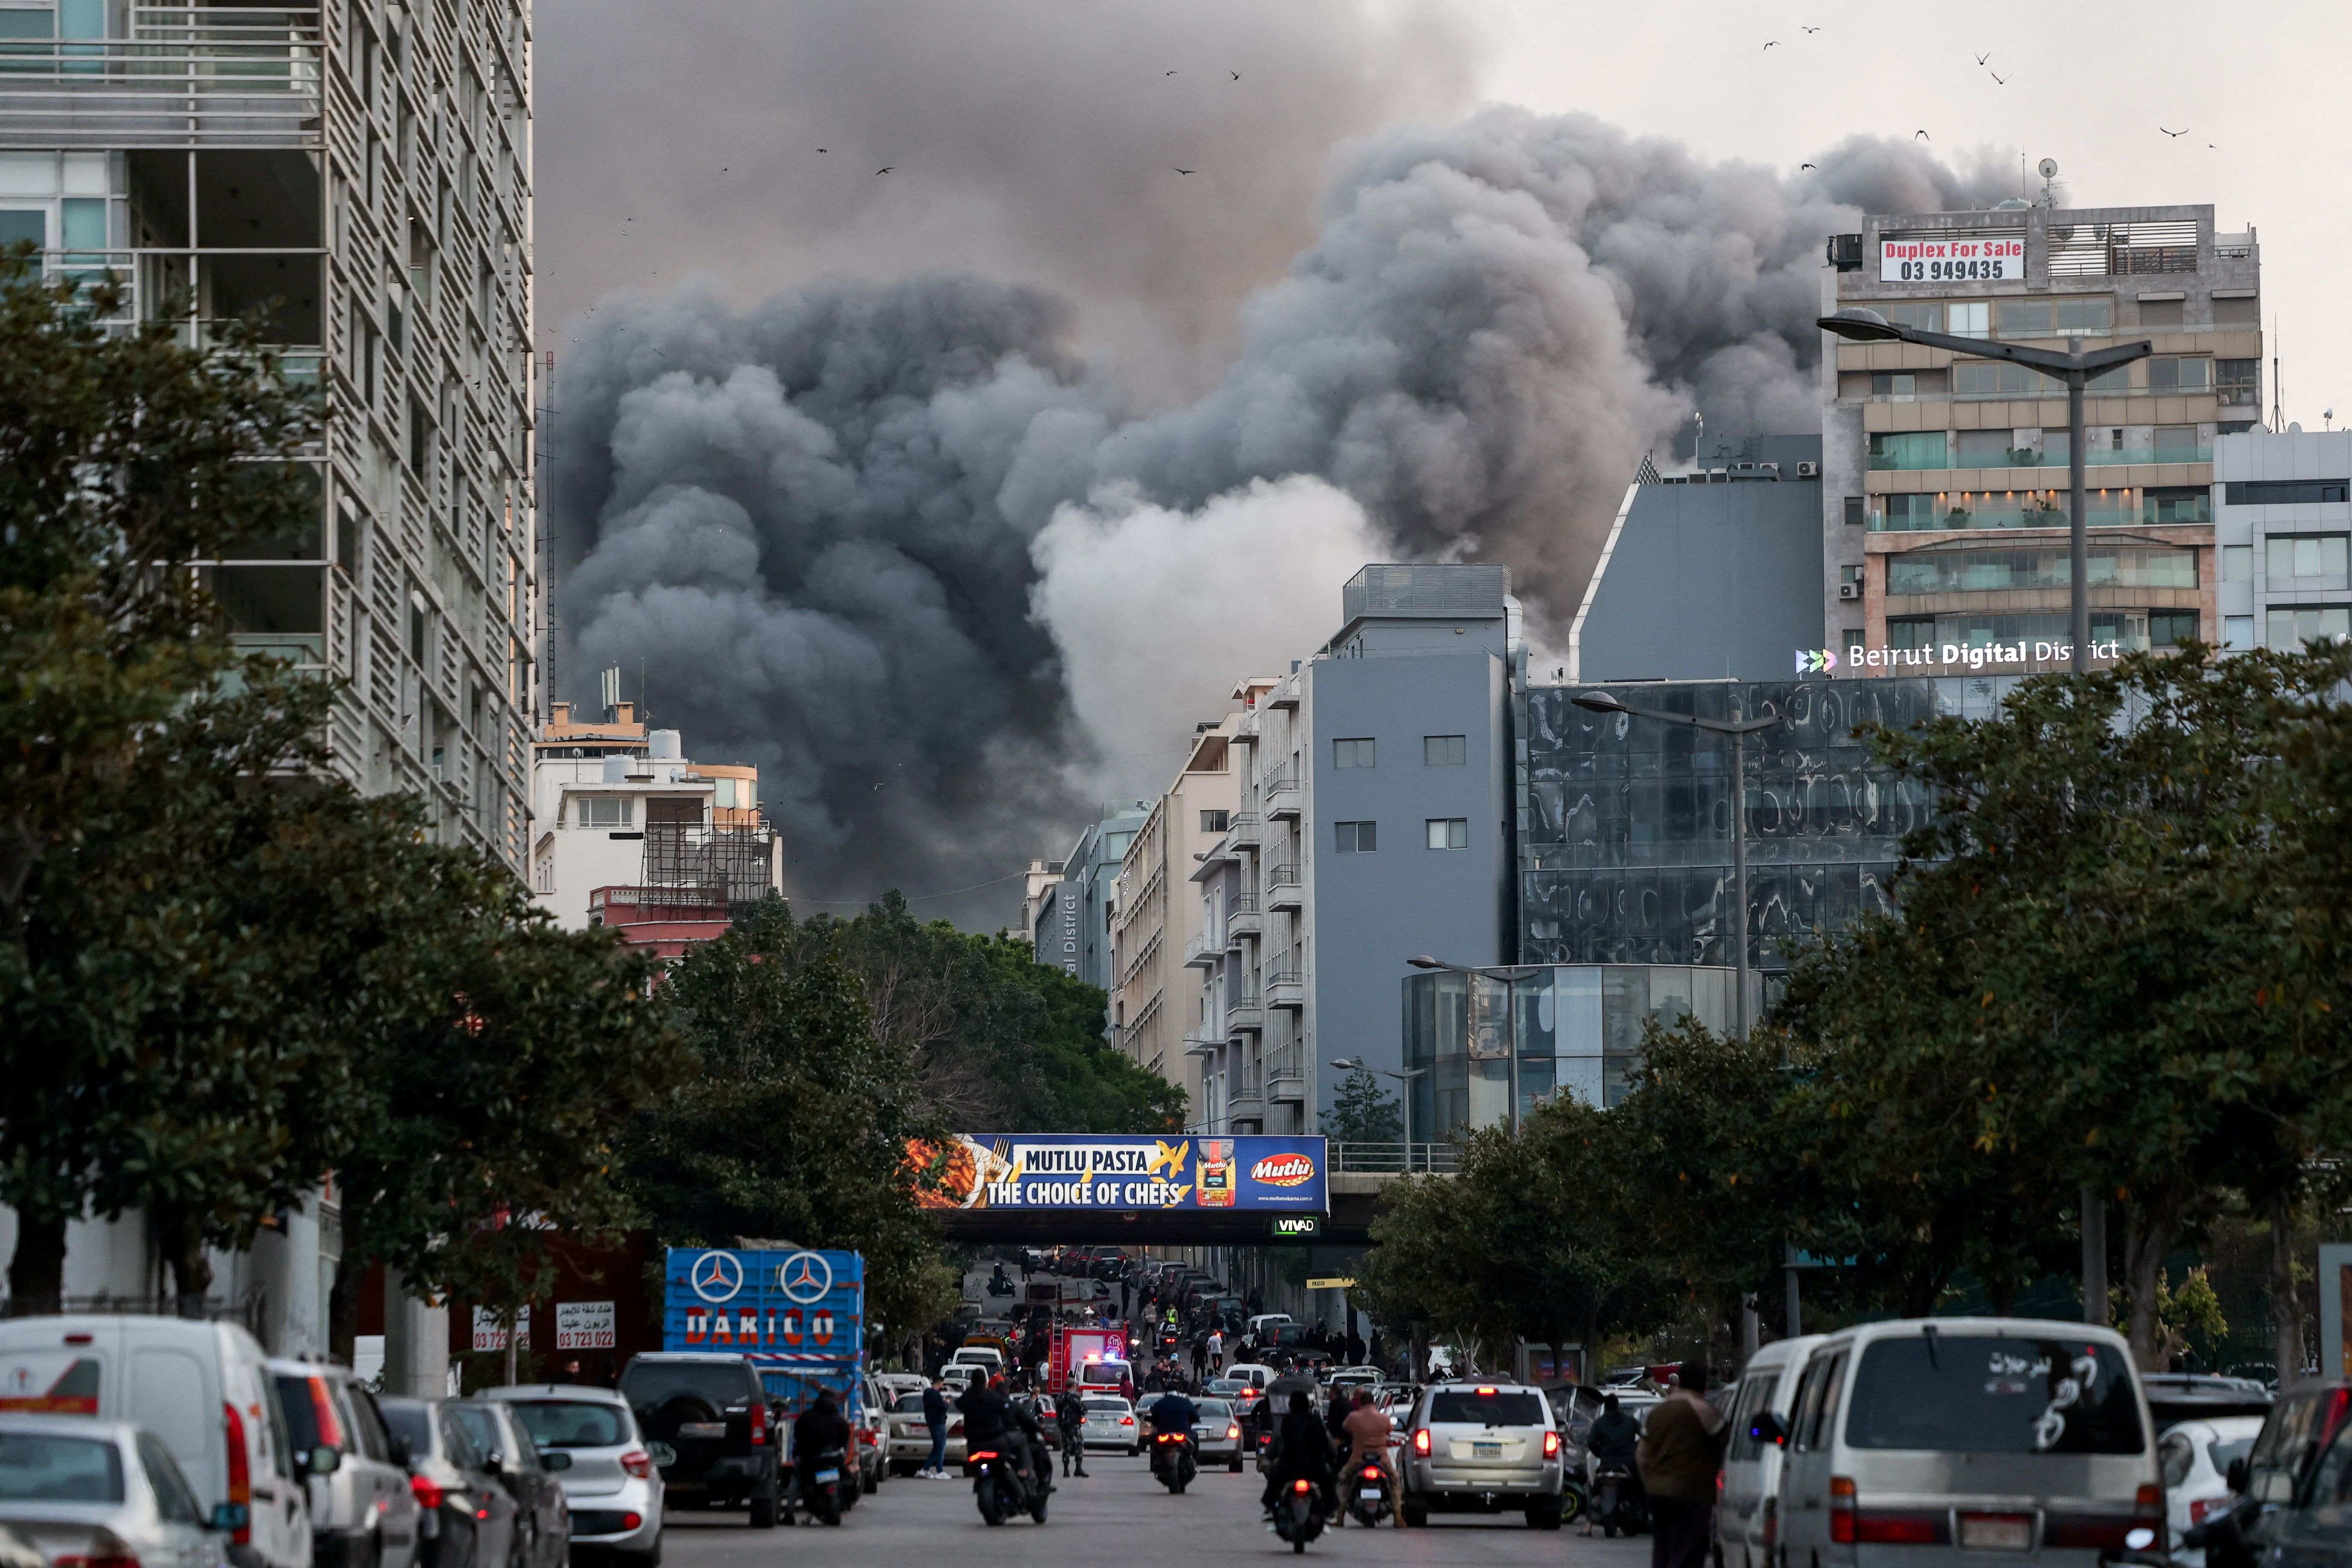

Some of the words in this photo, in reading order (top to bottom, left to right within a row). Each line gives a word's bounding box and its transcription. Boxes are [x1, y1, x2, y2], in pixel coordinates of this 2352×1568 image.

[1886, 242, 1945, 260] Duplex
[1951, 242, 1978, 257] For
[1984, 241, 2021, 256] Sale
[1901, 261, 1924, 280] 03
[1931, 260, 2003, 280] 949435
[1850, 644, 1933, 667] Beirut
[1942, 641, 2026, 669] Digital
[2035, 640, 2119, 661] Disict
[1063, 895, 1076, 953] District
[1026, 1150, 1087, 1171] MUTLU
[1092, 1150, 1147, 1171] PASTA
[1251, 1158, 1310, 1179] Mutlu
[989, 1183, 1021, 1205] THE
[1026, 1183, 1092, 1205] CHOICE
[1096, 1183, 1120, 1205] OF
[1124, 1183, 1180, 1205] CHEFS
[686, 1306, 834, 1346] DARICO
[475, 1332, 487, 1348] 03
[559, 1332, 572, 1347] 03
[574, 1332, 592, 1347] 723
[595, 1331, 613, 1346] 022
